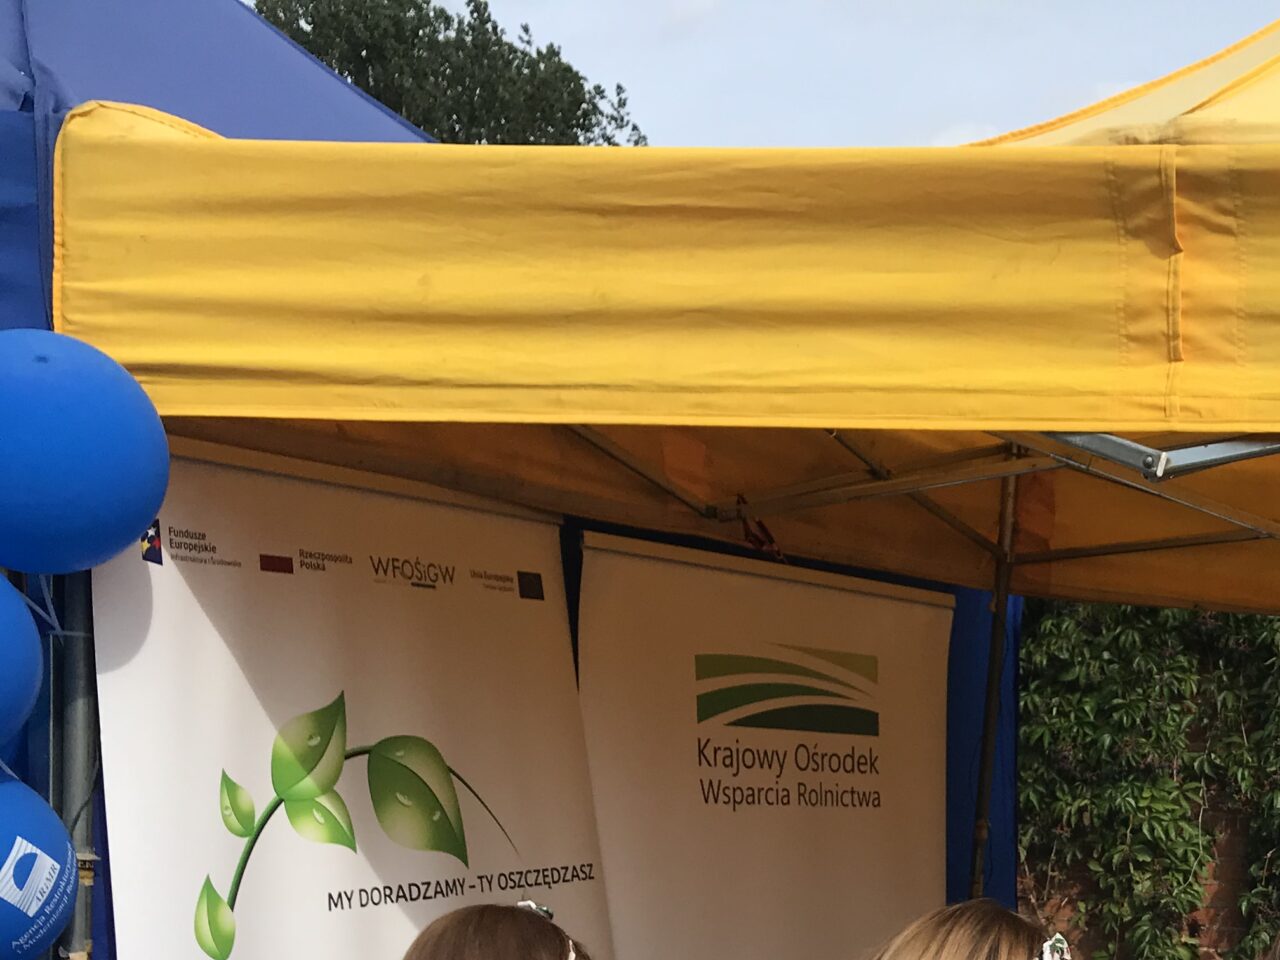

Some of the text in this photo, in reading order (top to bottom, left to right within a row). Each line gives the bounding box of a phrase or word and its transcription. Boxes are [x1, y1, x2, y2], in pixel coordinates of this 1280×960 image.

[168, 526, 207, 541] Fundusze
[169, 538, 217, 554] Europejskie
[300, 560, 326, 572] Polska
[697, 737, 880, 778] Krajowy Ośrodek
[700, 779, 882, 812] Wsparcia Rolnictwa
[328, 889, 354, 911] MY
[359, 877, 466, 908] DORADZAMY
[477, 873, 493, 893] TY
[498, 863, 595, 890] OSZCZĘDZASZ
